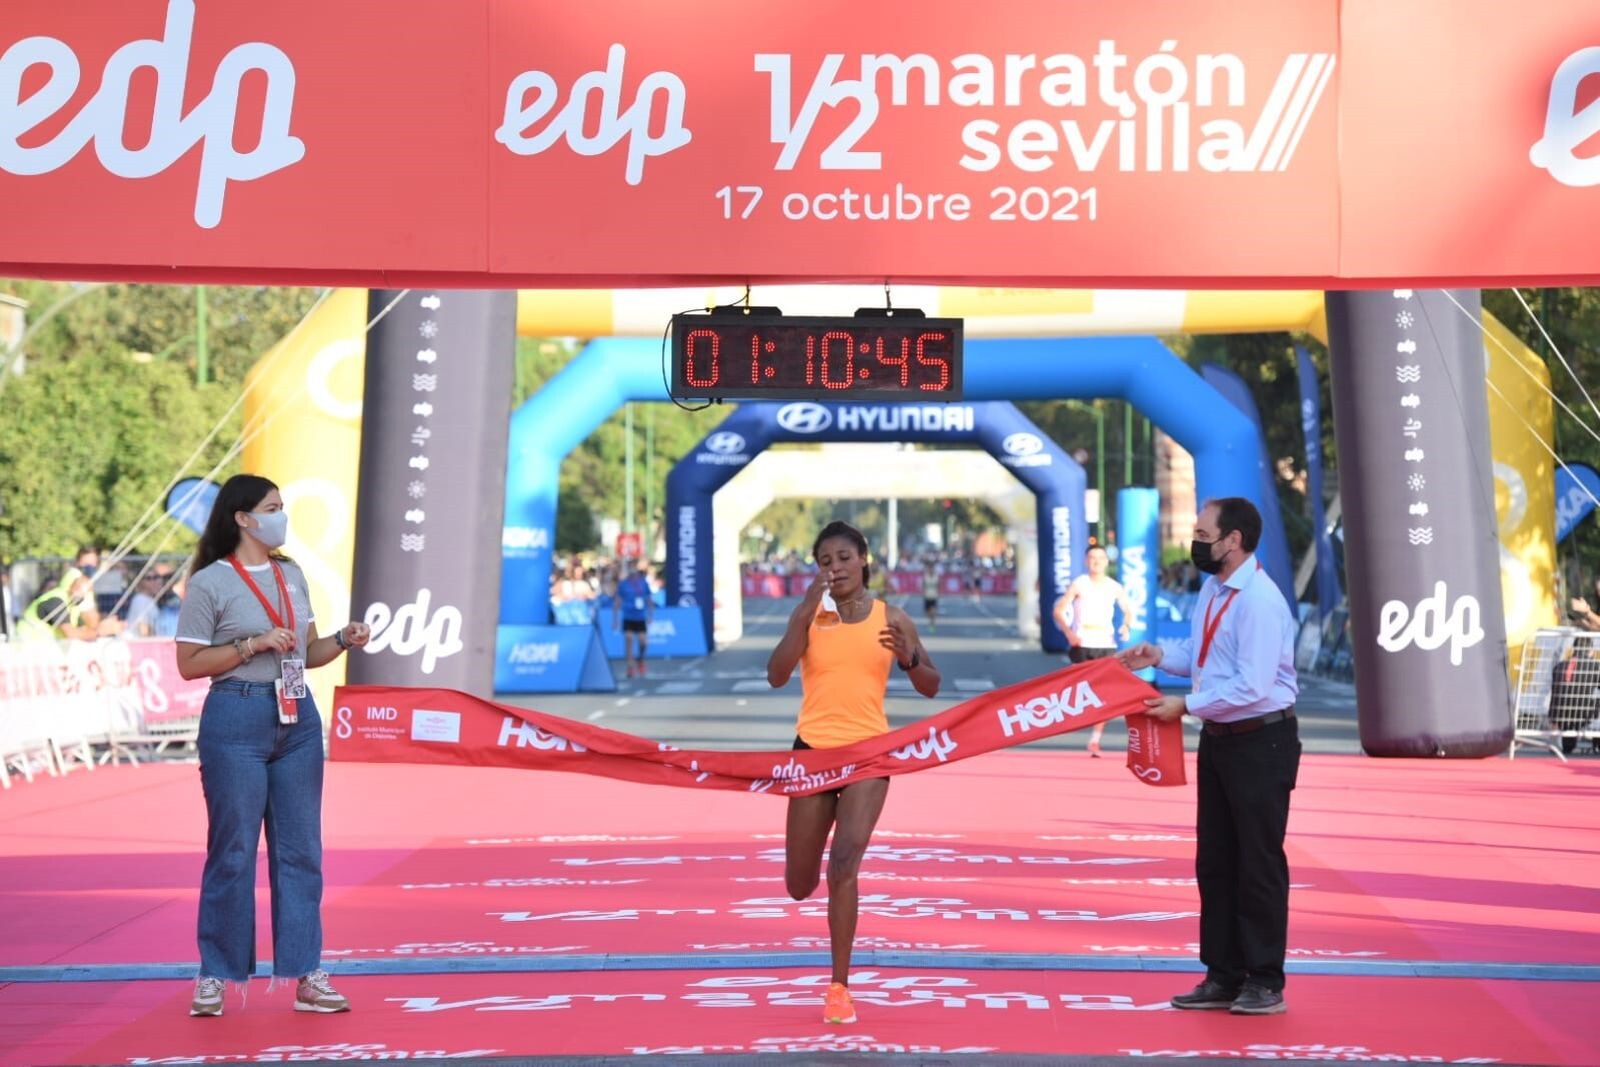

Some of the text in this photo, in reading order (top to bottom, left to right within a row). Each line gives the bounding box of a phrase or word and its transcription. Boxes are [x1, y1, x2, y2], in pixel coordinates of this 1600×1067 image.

[861, 39, 1246, 108] maratón
[0, 0, 305, 229] edp
[494, 43, 692, 186] edp
[958, 101, 1238, 173] sevilla
[715, 184, 1099, 222] 17 octubre 2021
[838, 406, 974, 431] HYUNDAI
[680, 507, 696, 593] HYUNDAI
[363, 588, 463, 674] edp
[508, 643, 561, 664] HOKA
[1377, 580, 1485, 666] edp
[367, 707, 398, 720] IMD
[997, 680, 1105, 737] HOKA
[1129, 727, 1141, 753] IMD
[684, 971, 978, 989] edp
